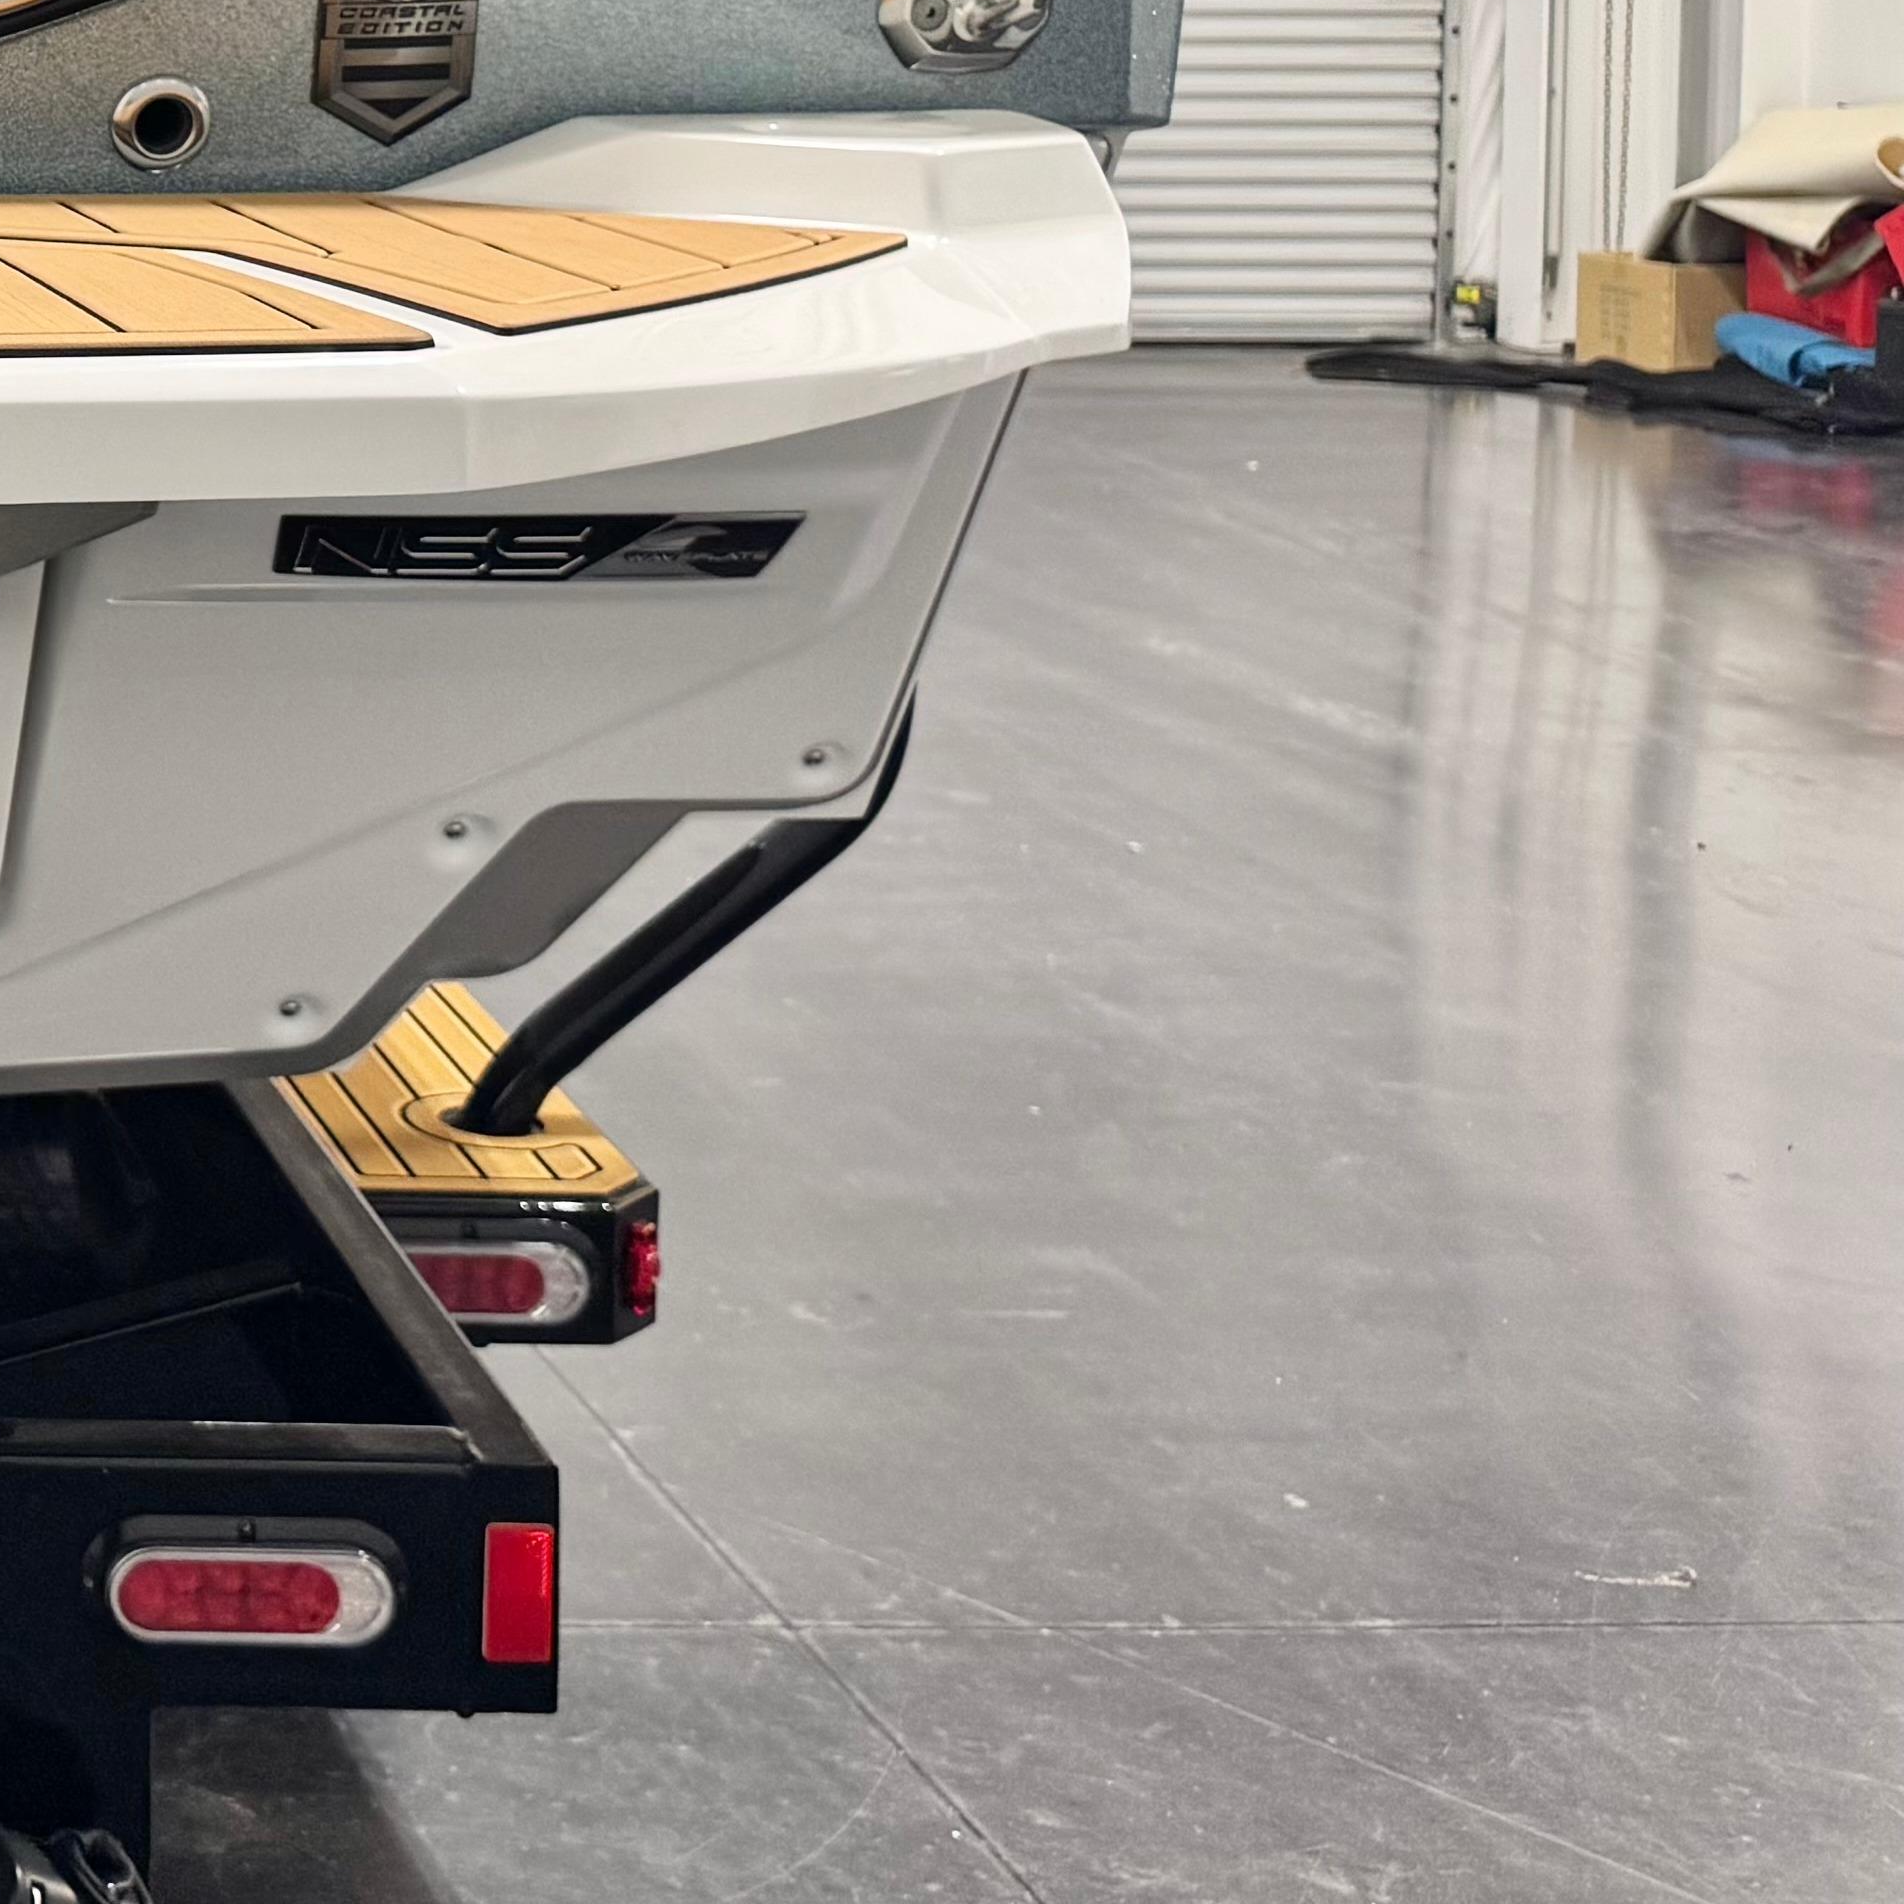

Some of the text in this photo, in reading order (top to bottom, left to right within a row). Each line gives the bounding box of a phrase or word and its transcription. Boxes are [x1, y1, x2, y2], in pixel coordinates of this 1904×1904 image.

[339, 4, 466, 19] COASTAL
[337, 20, 464, 34] EDITION
[292, 526, 594, 576] NSS
